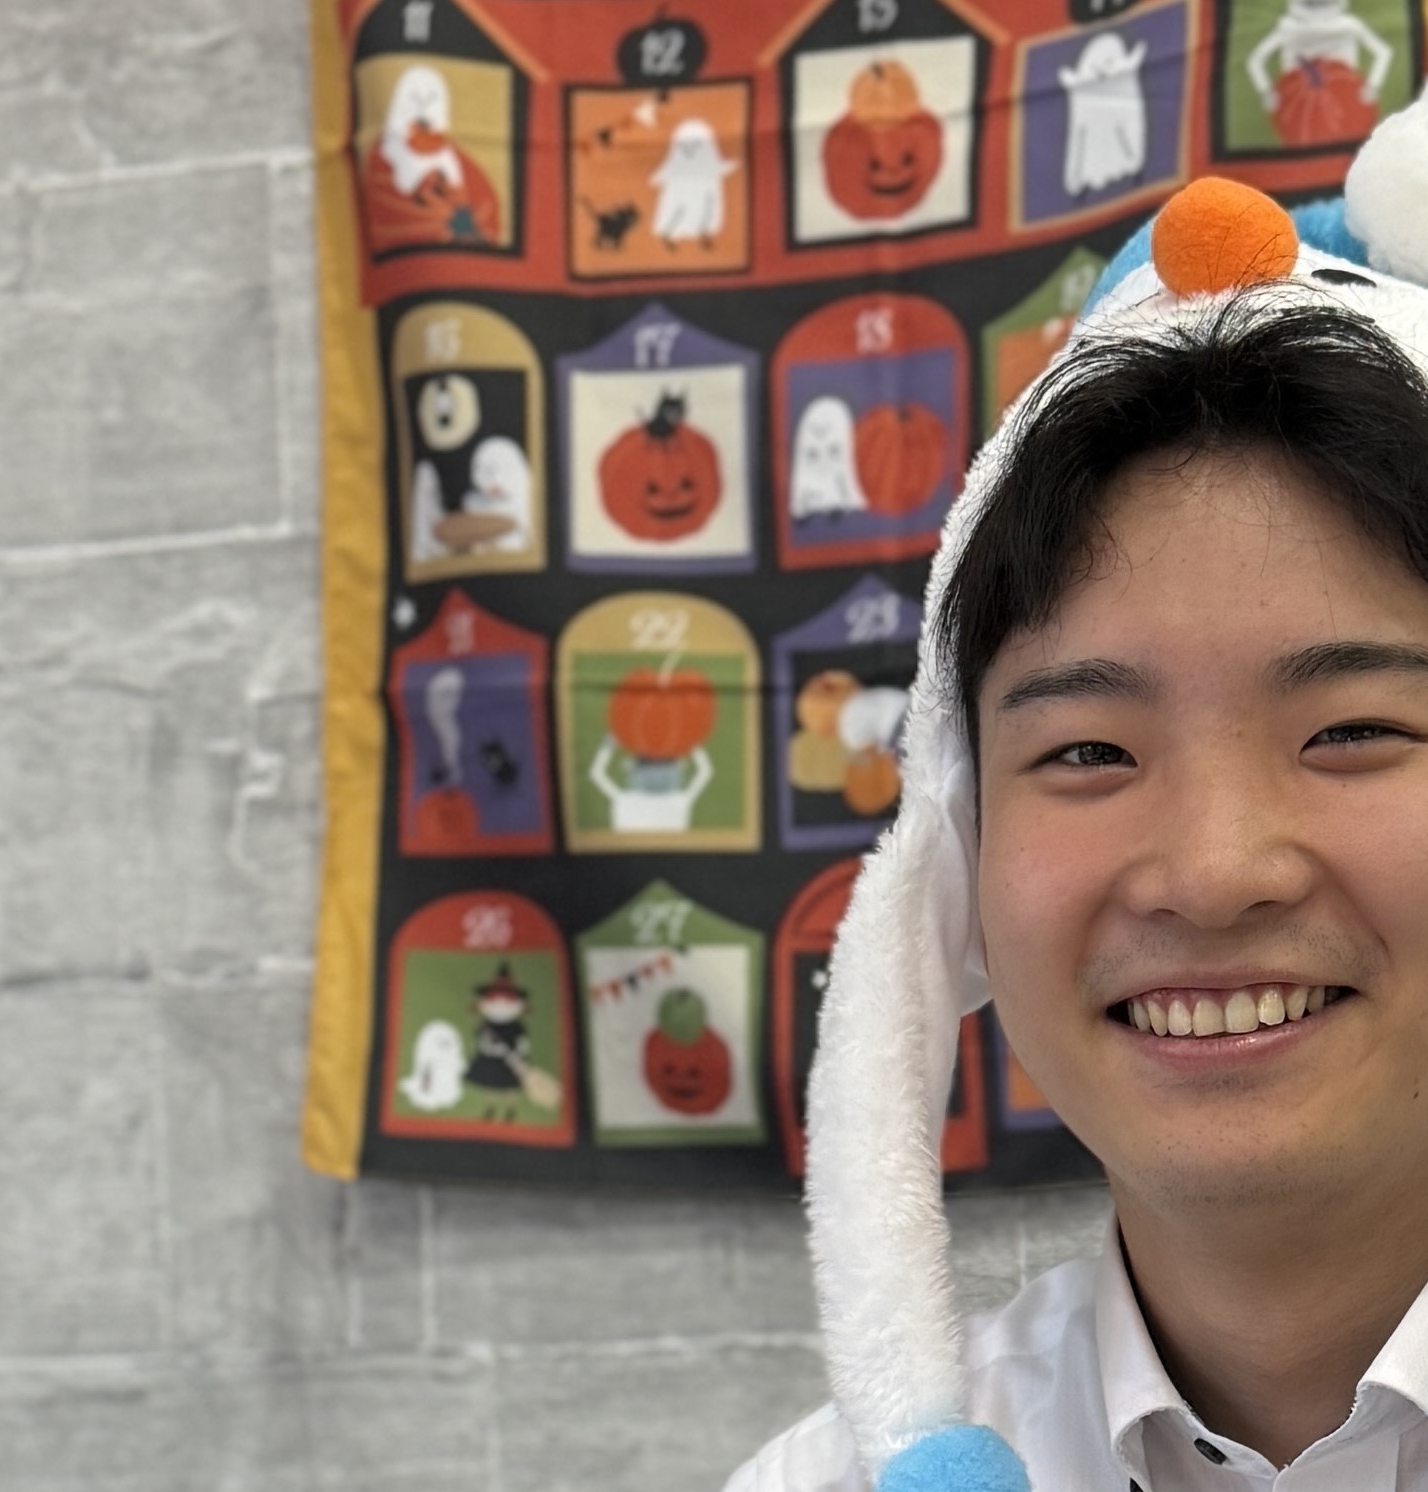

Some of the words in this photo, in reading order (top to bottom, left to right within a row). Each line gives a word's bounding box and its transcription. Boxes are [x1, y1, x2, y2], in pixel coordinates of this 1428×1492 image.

[640, 29, 685, 76] 12
[629, 611, 689, 650] 22
[629, 900, 694, 943] 27
